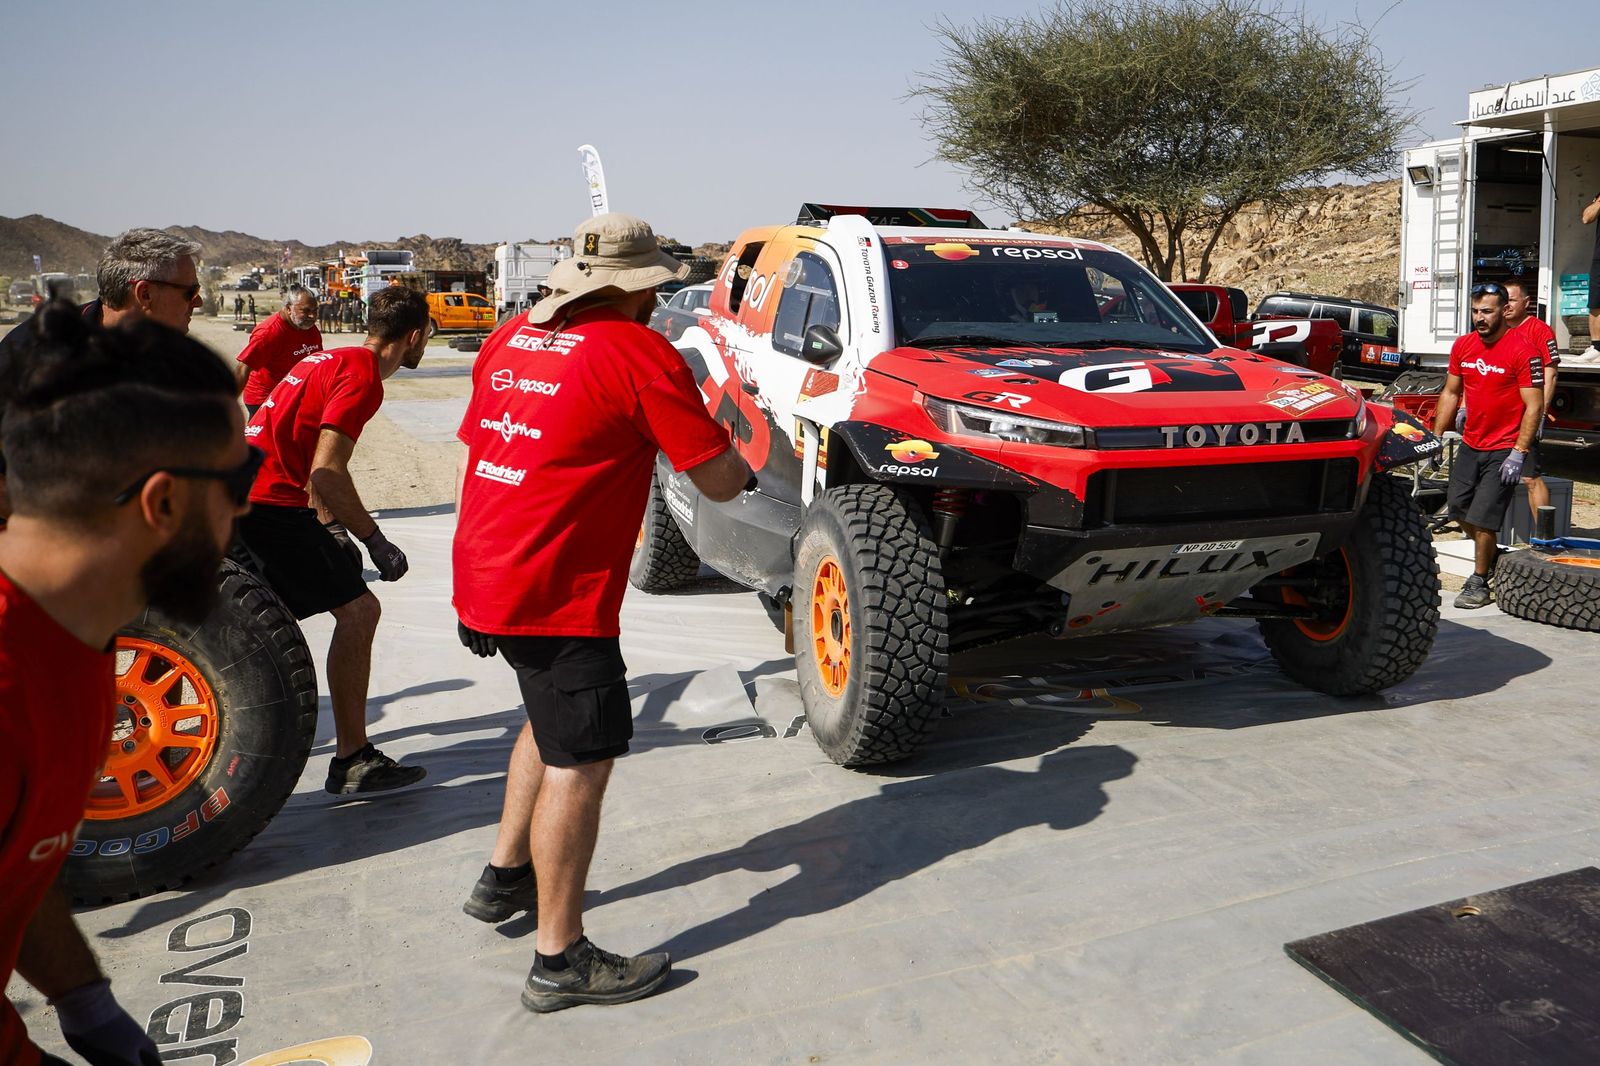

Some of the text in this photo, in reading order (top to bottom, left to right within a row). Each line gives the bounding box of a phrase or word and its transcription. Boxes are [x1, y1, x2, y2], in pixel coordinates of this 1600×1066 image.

[991, 246, 1084, 261] repsol
[719, 253, 777, 312] resol
[871, 304, 880, 334] Racing
[550, 331, 586, 342] OYOTA
[515, 378, 561, 397] repsol
[962, 391, 1033, 408] GR
[480, 411, 543, 443] overdrive
[1160, 422, 1306, 449] TOYOTA
[1413, 438, 1440, 453] repsol
[878, 463, 940, 478] repsol
[1182, 543, 1199, 552] NP
[1216, 541, 1238, 550] 504
[1087, 548, 1282, 586] HILUX
